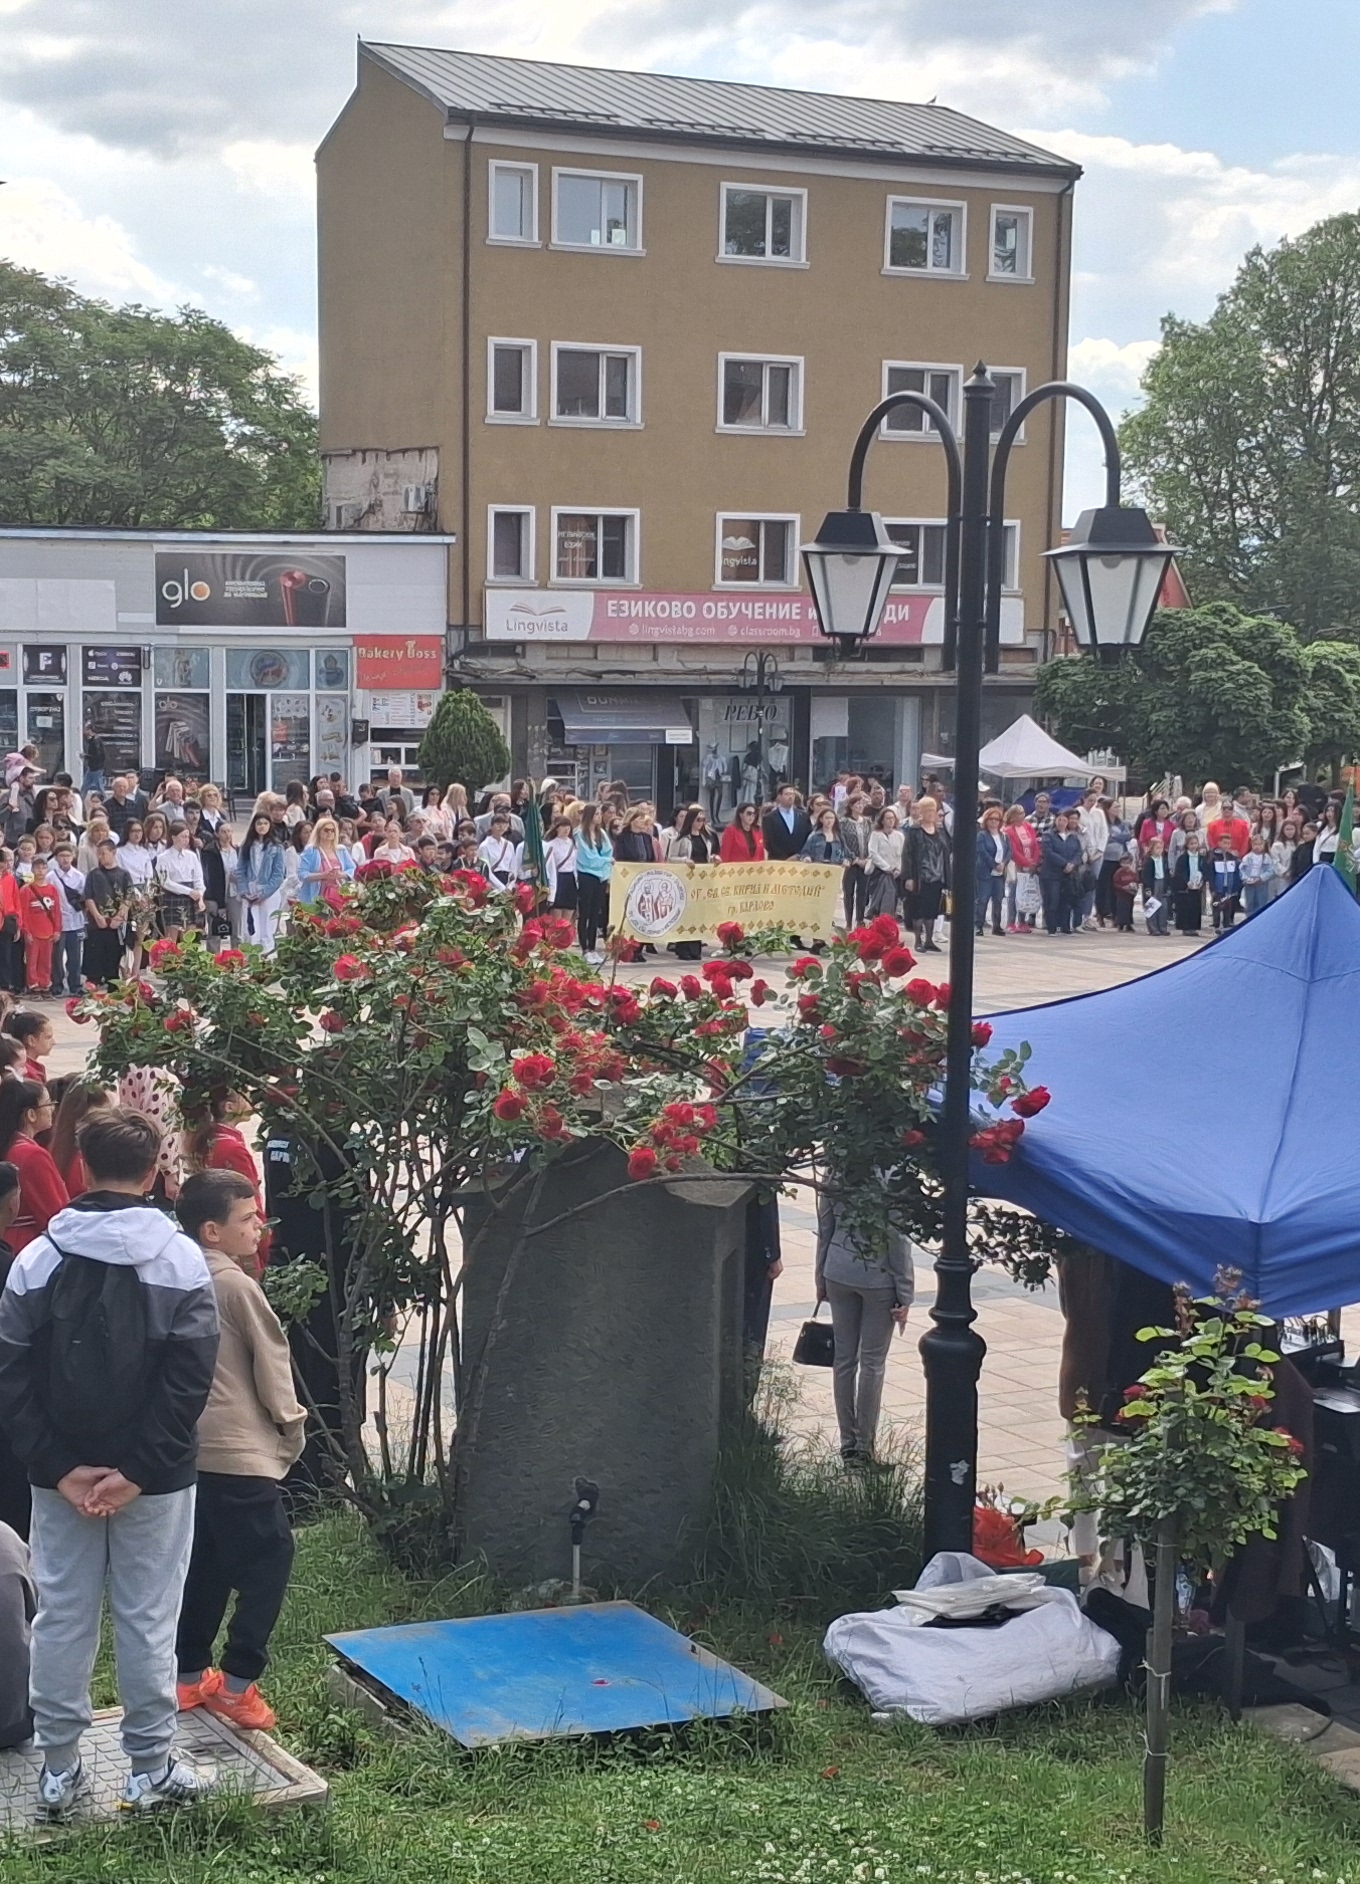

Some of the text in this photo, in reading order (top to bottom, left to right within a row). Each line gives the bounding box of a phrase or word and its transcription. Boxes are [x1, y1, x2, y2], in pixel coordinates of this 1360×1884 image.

[162, 568, 211, 608] glo
[607, 600, 696, 618] ЕЗИКОВО
[702, 602, 801, 620] ОБУЧЕНИЕ
[506, 618, 568, 635] Lingvista
[642, 624, 715, 637] lingvistabg.com
[358, 646, 404, 661] Bakery
